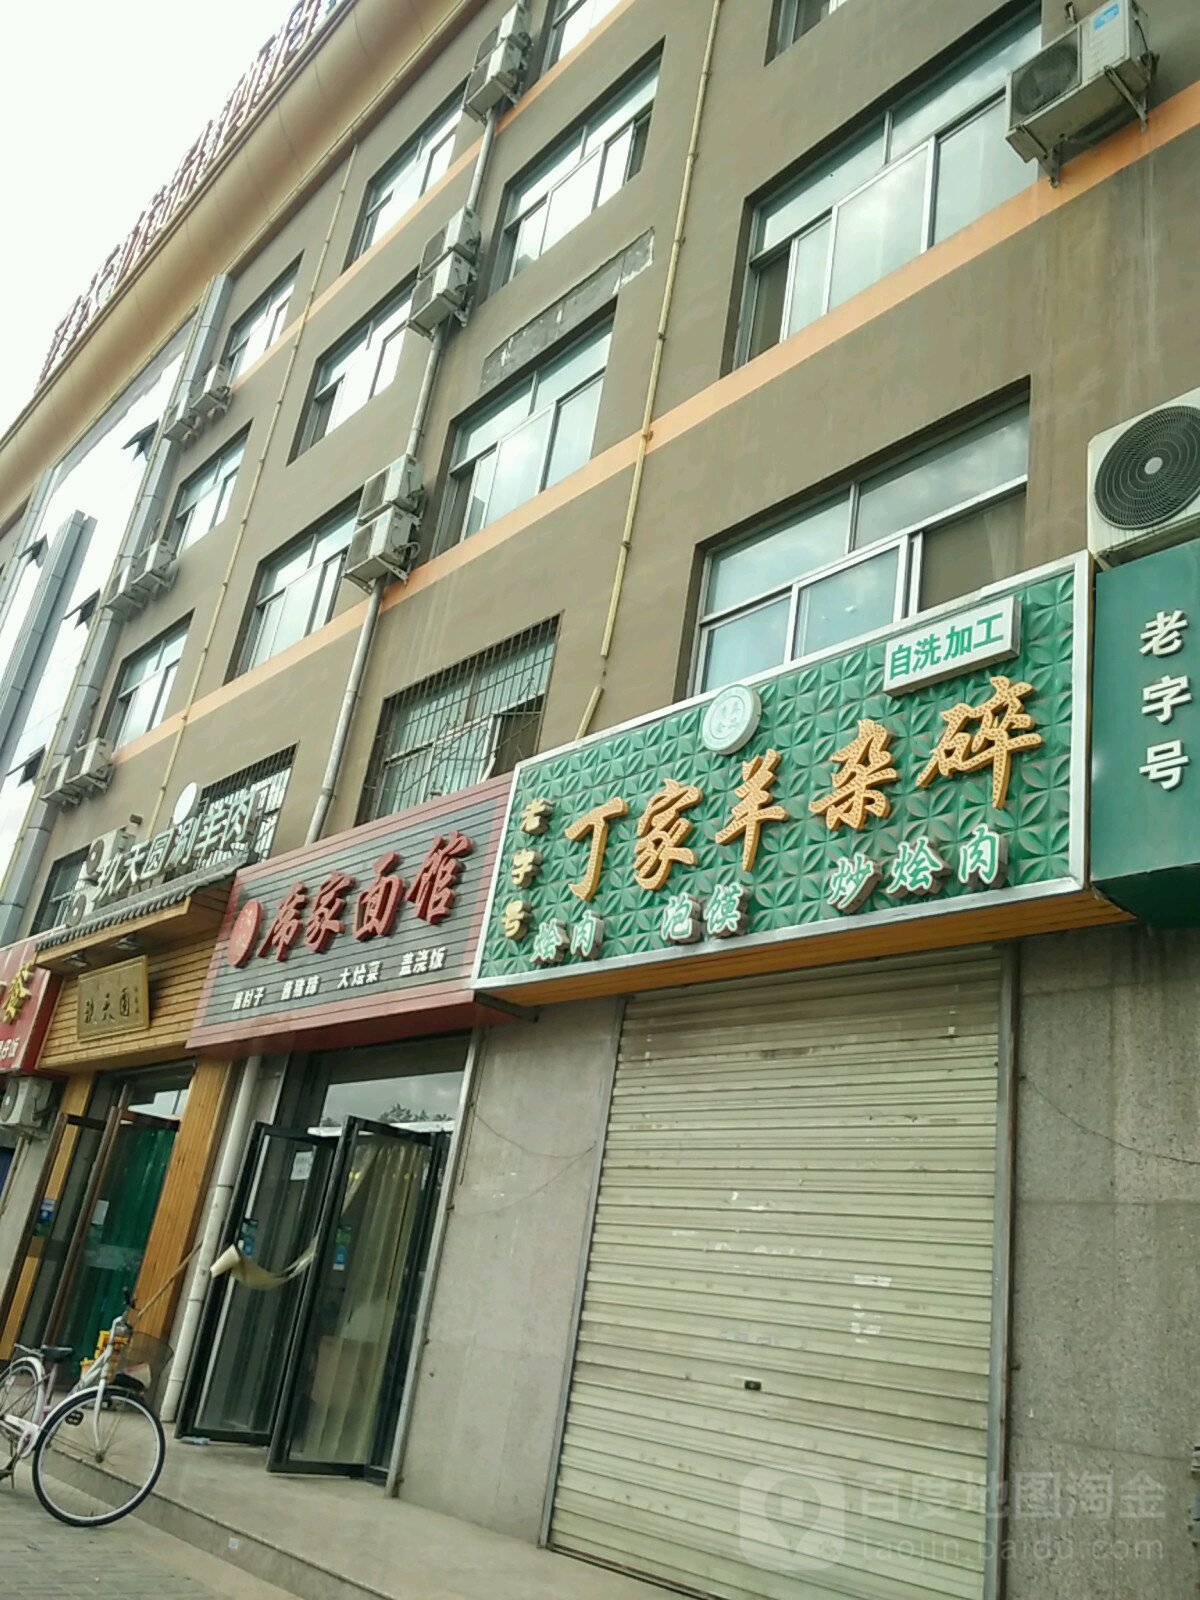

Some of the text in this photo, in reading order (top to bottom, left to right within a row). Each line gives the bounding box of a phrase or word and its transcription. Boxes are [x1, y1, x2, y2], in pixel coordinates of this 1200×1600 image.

[889, 611, 1004, 680] 自洗加工
[1138, 609, 1193, 790] 老字号
[564, 675, 1045, 901] 丁家羊杂碎
[501, 797, 553, 940] 老字号
[530, 823, 1007, 964] 烩肉 泡馍 炒烩肉
[337, 961, 382, 990] 大烩菜
[398, 947, 446, 977] 盖浇饭
